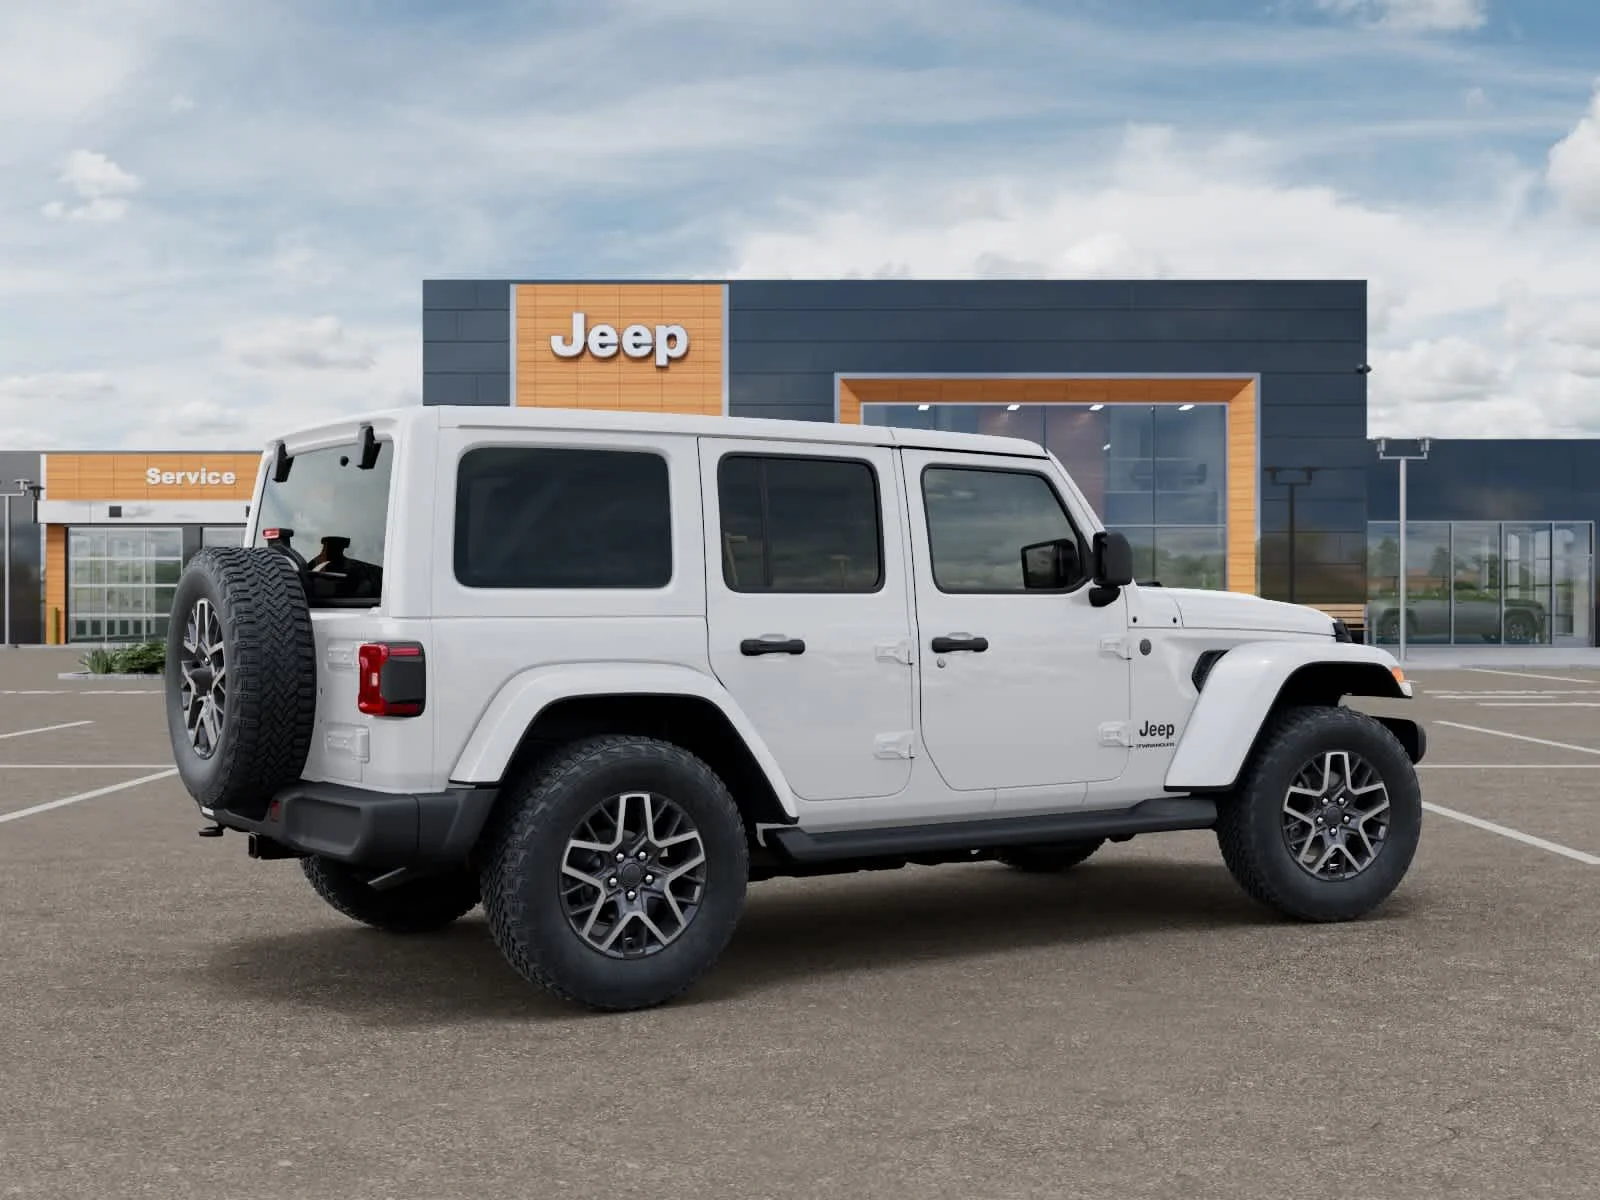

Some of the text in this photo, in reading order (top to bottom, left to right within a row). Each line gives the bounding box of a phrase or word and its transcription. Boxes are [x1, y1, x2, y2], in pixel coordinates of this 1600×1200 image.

[550, 312, 689, 367] Jeep
[146, 467, 236, 485] Service
[1139, 720, 1175, 740] Jeep
